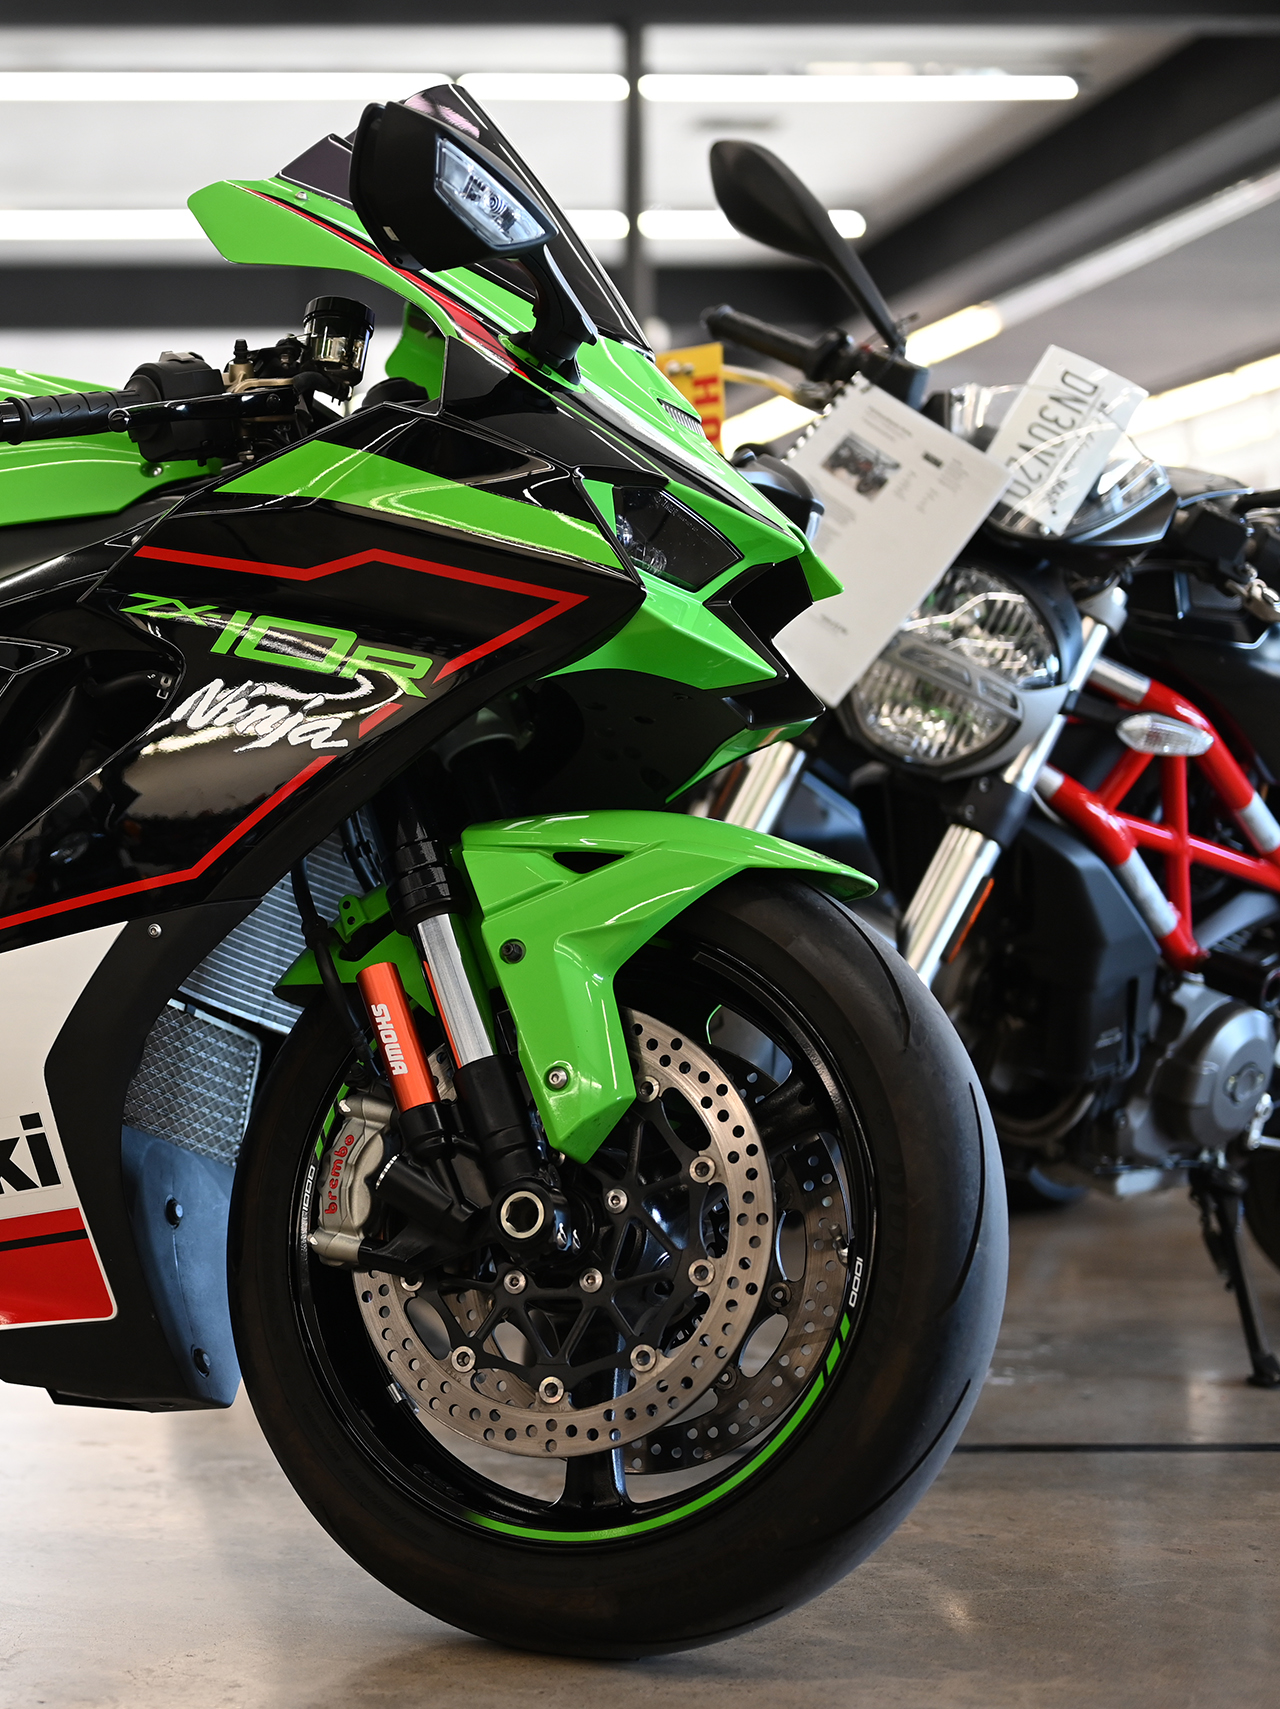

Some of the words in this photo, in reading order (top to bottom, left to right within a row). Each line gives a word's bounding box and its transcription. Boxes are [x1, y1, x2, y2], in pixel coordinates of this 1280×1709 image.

[120, 592, 433, 698] ZX-10R
[171, 678, 348, 753] Ninja
[370, 1003, 408, 1076] SHOWA
[303, 1165, 316, 1212] 1000
[325, 1134, 355, 1214] brembo
[848, 1256, 864, 1308] 1000
